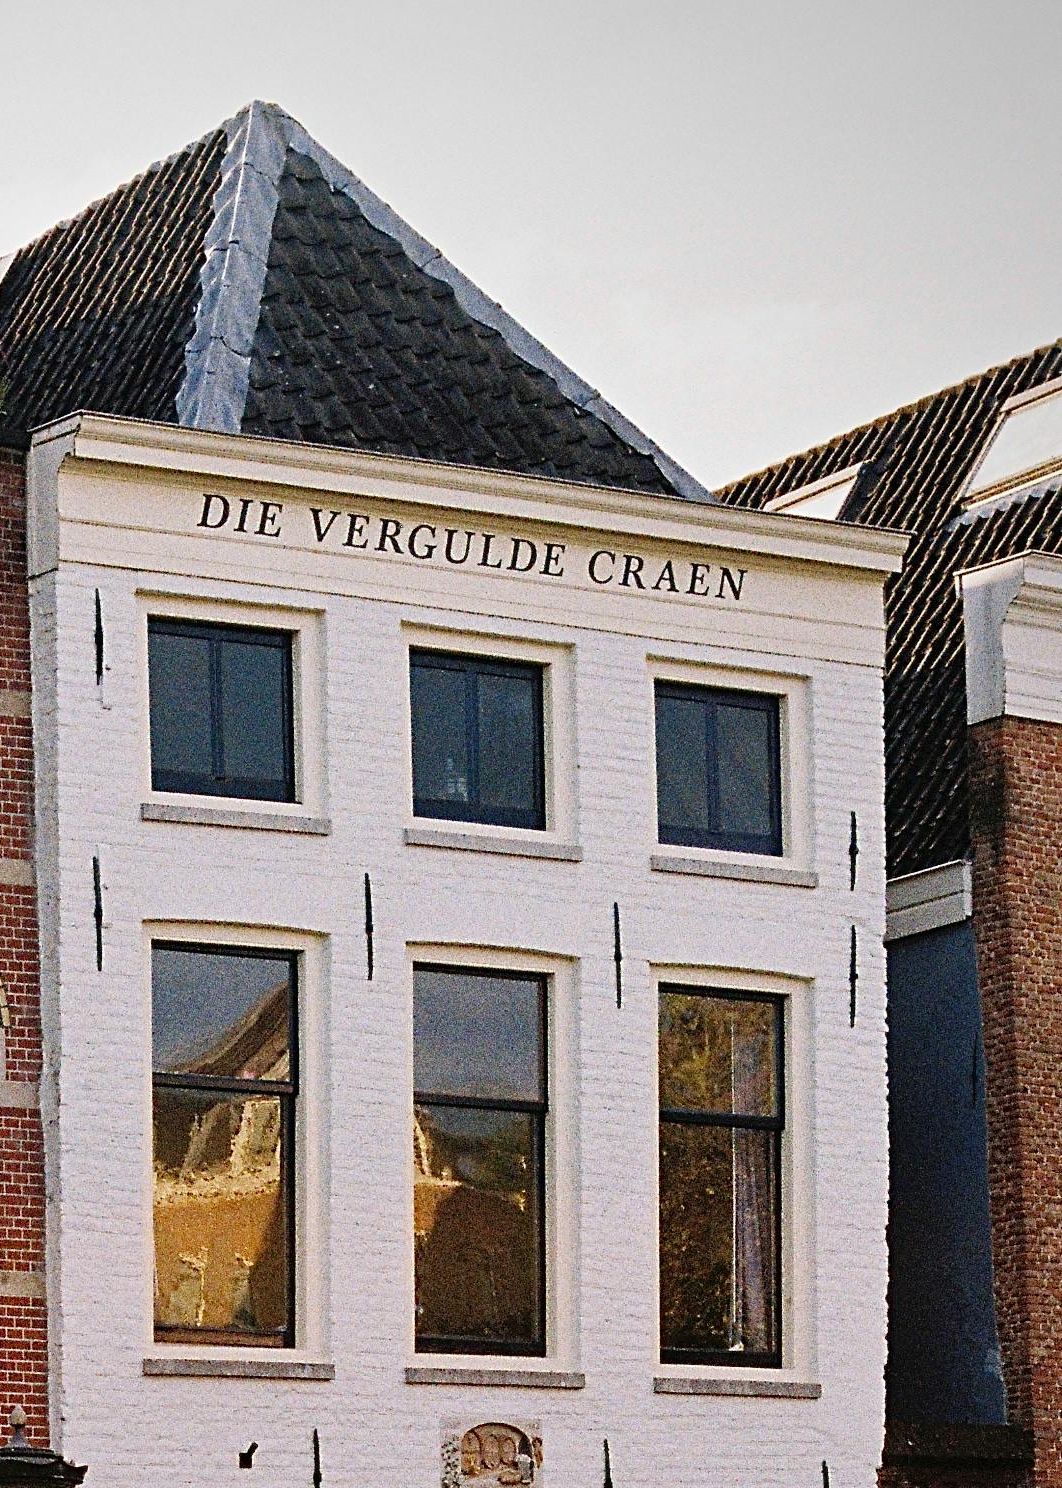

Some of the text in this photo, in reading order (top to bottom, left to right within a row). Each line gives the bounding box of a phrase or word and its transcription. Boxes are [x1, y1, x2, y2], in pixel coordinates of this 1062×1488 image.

[196, 493, 748, 600] DIE VERGULDE CRAEN
